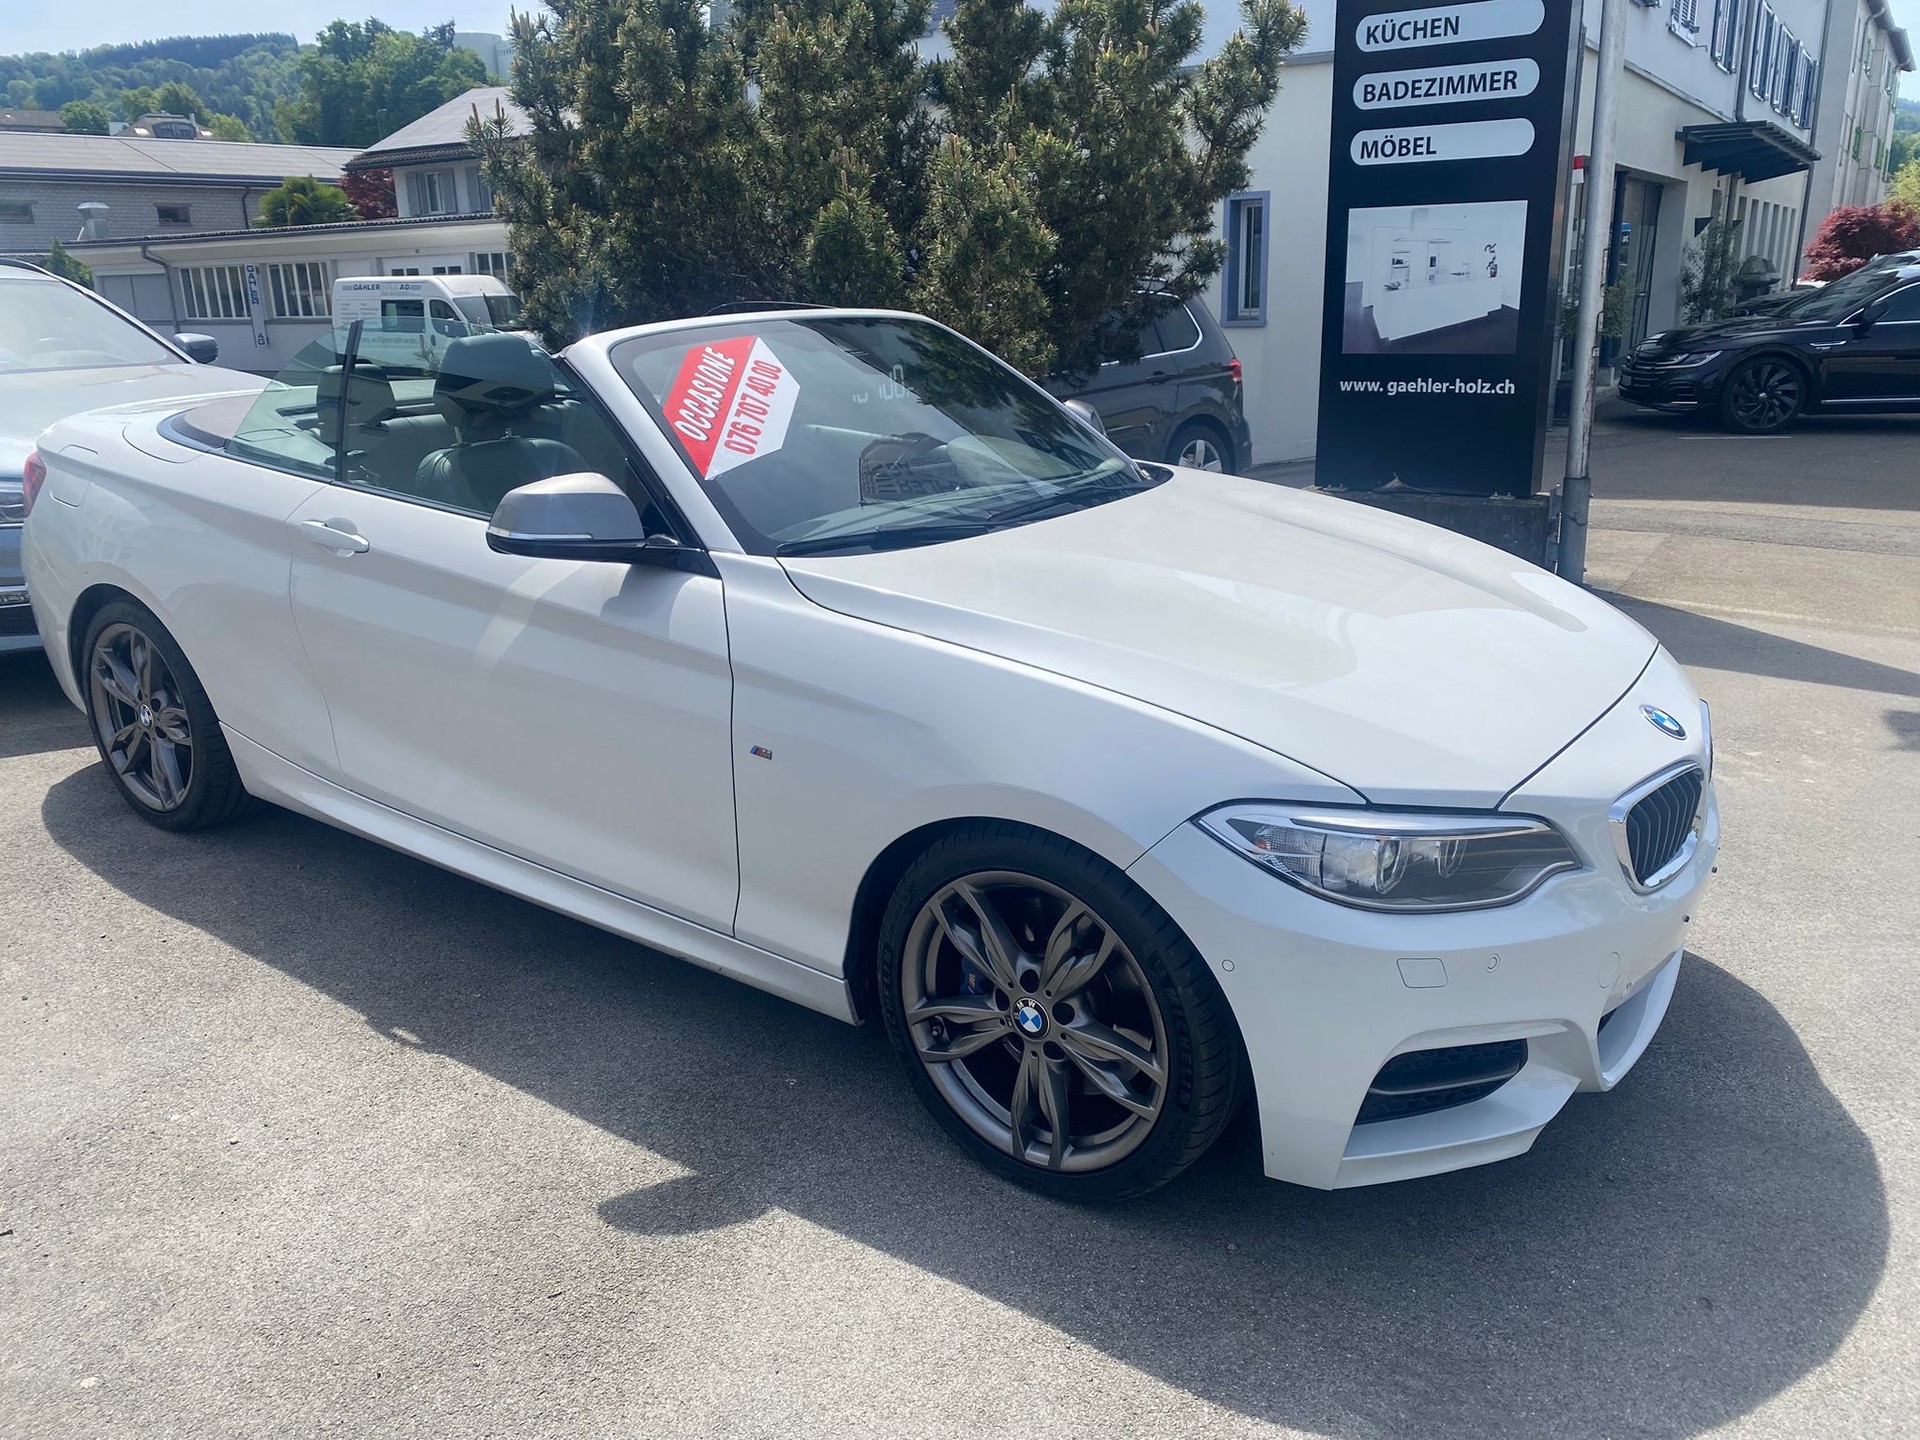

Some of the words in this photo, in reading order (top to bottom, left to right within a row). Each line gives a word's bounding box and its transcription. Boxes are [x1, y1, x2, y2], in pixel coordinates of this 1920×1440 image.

[1366, 16, 1460, 45] KÜCHEN
[1363, 70, 1518, 103] BADEZIMMER
[1360, 135, 1437, 160] MÖBEL
[257, 332, 266, 345] AG
[750, 359, 782, 381] 00
[674, 346, 735, 442] OCCASIONE
[745, 375, 776, 397] 40
[1340, 380, 1384, 392] www.
[1387, 378, 1516, 396] gaehler-holz.ch
[734, 392, 770, 424] 707
[723, 421, 762, 455] 076
